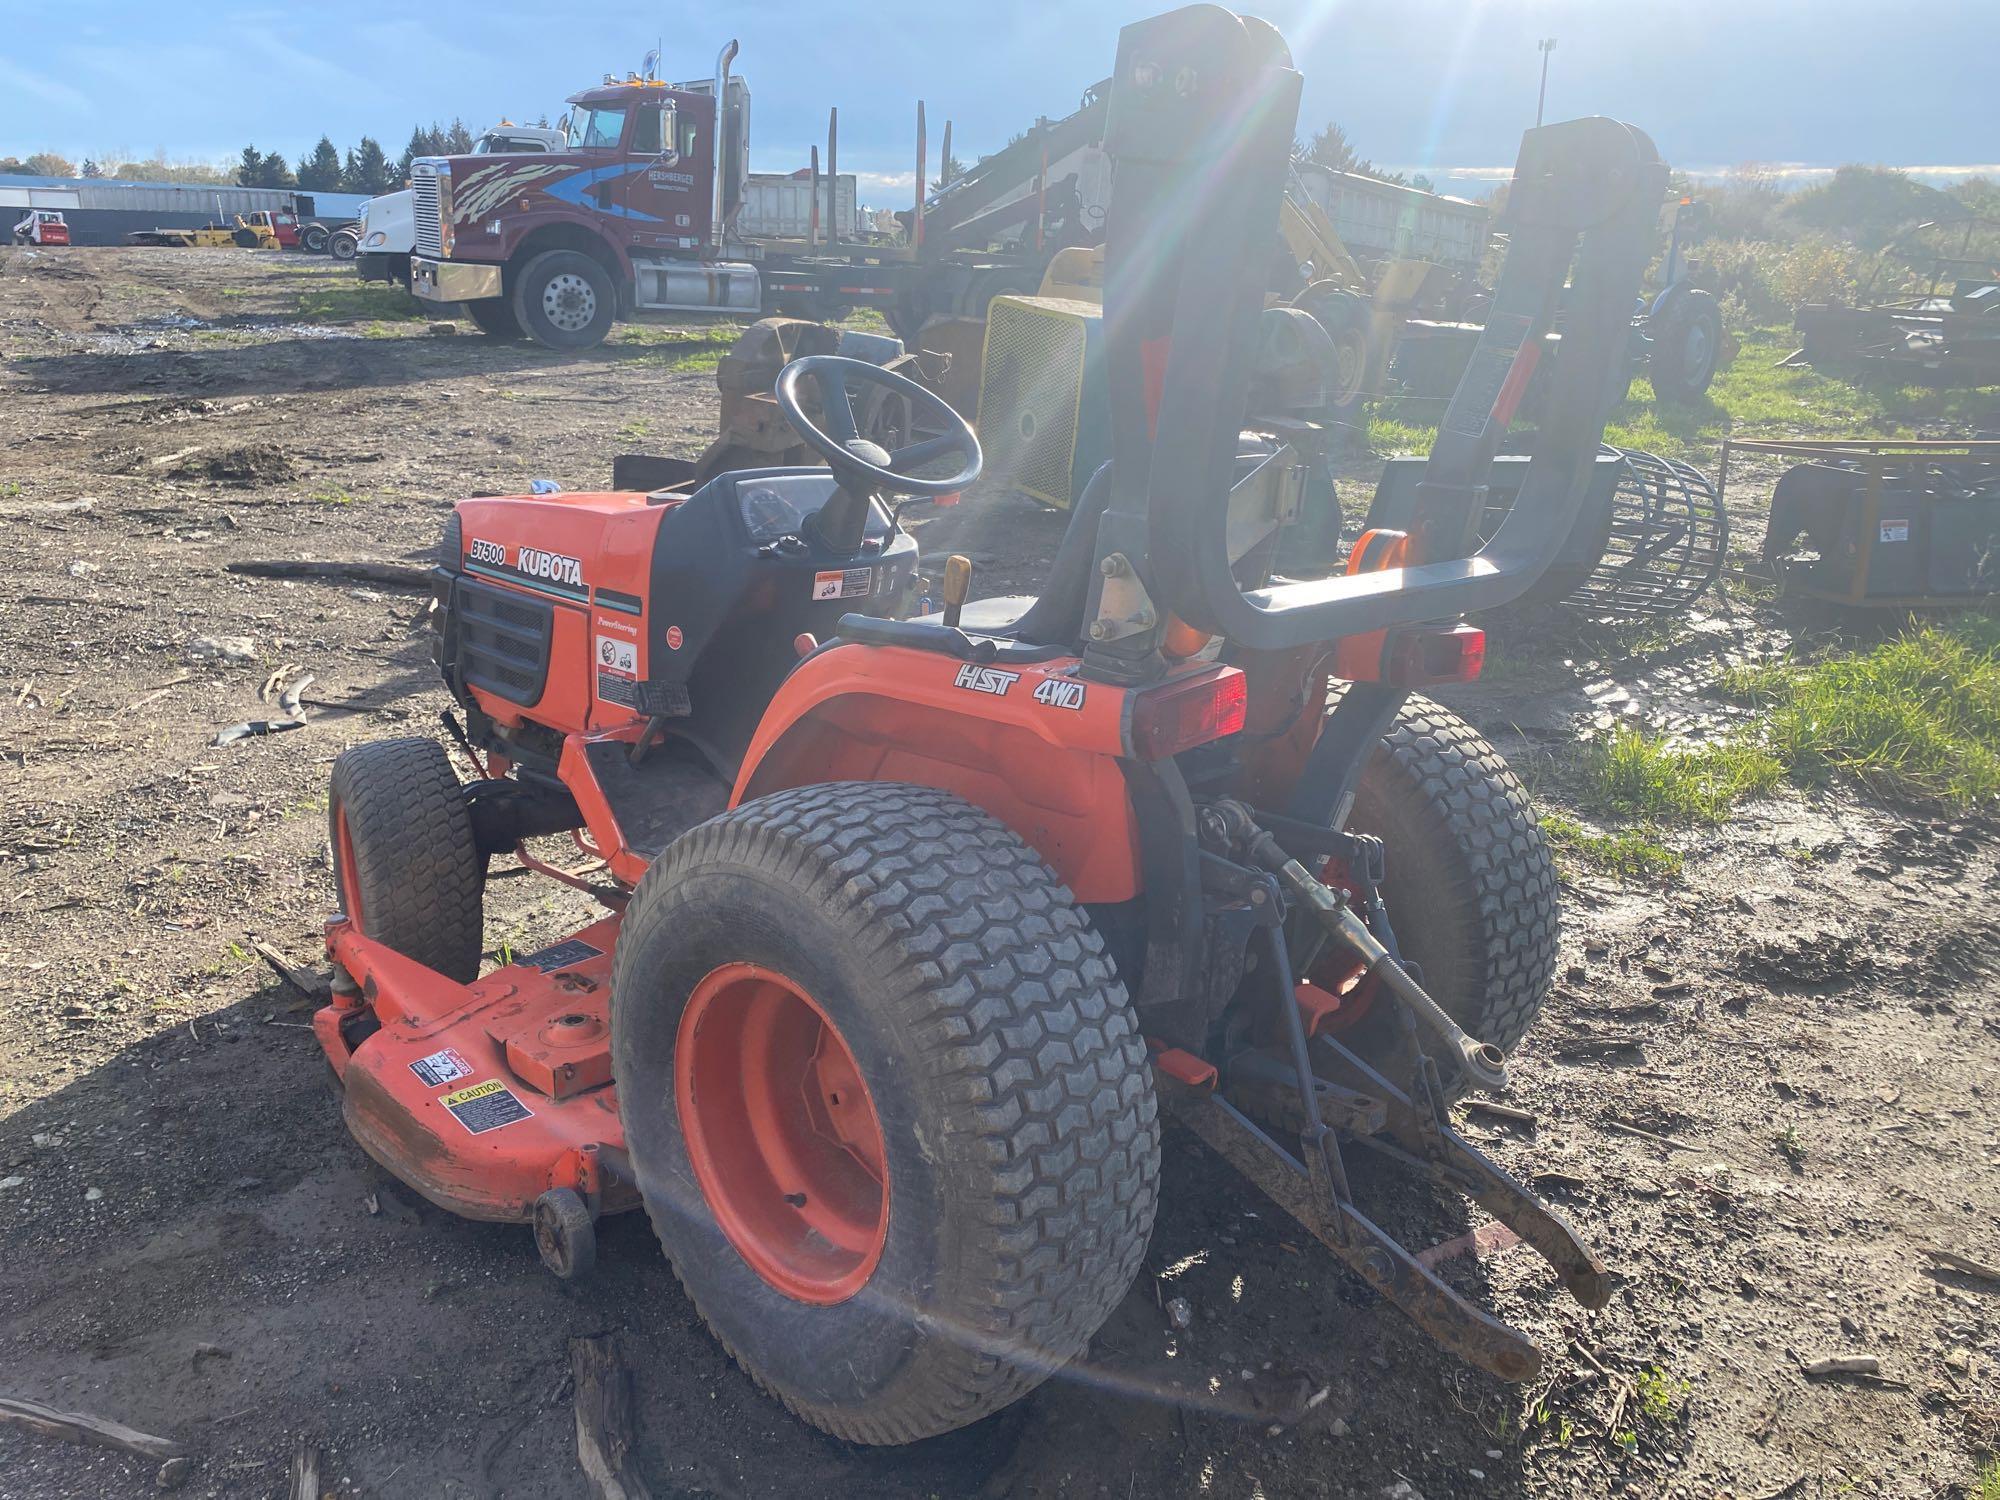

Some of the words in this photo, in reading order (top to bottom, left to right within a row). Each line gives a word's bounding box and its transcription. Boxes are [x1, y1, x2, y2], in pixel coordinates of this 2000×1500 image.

[471, 539, 505, 566] B7500
[517, 547, 582, 586] KUBOTA
[953, 663, 1021, 696] HST
[1033, 678, 1087, 710] 4WD
[459, 1081, 503, 1101] CAUTION
